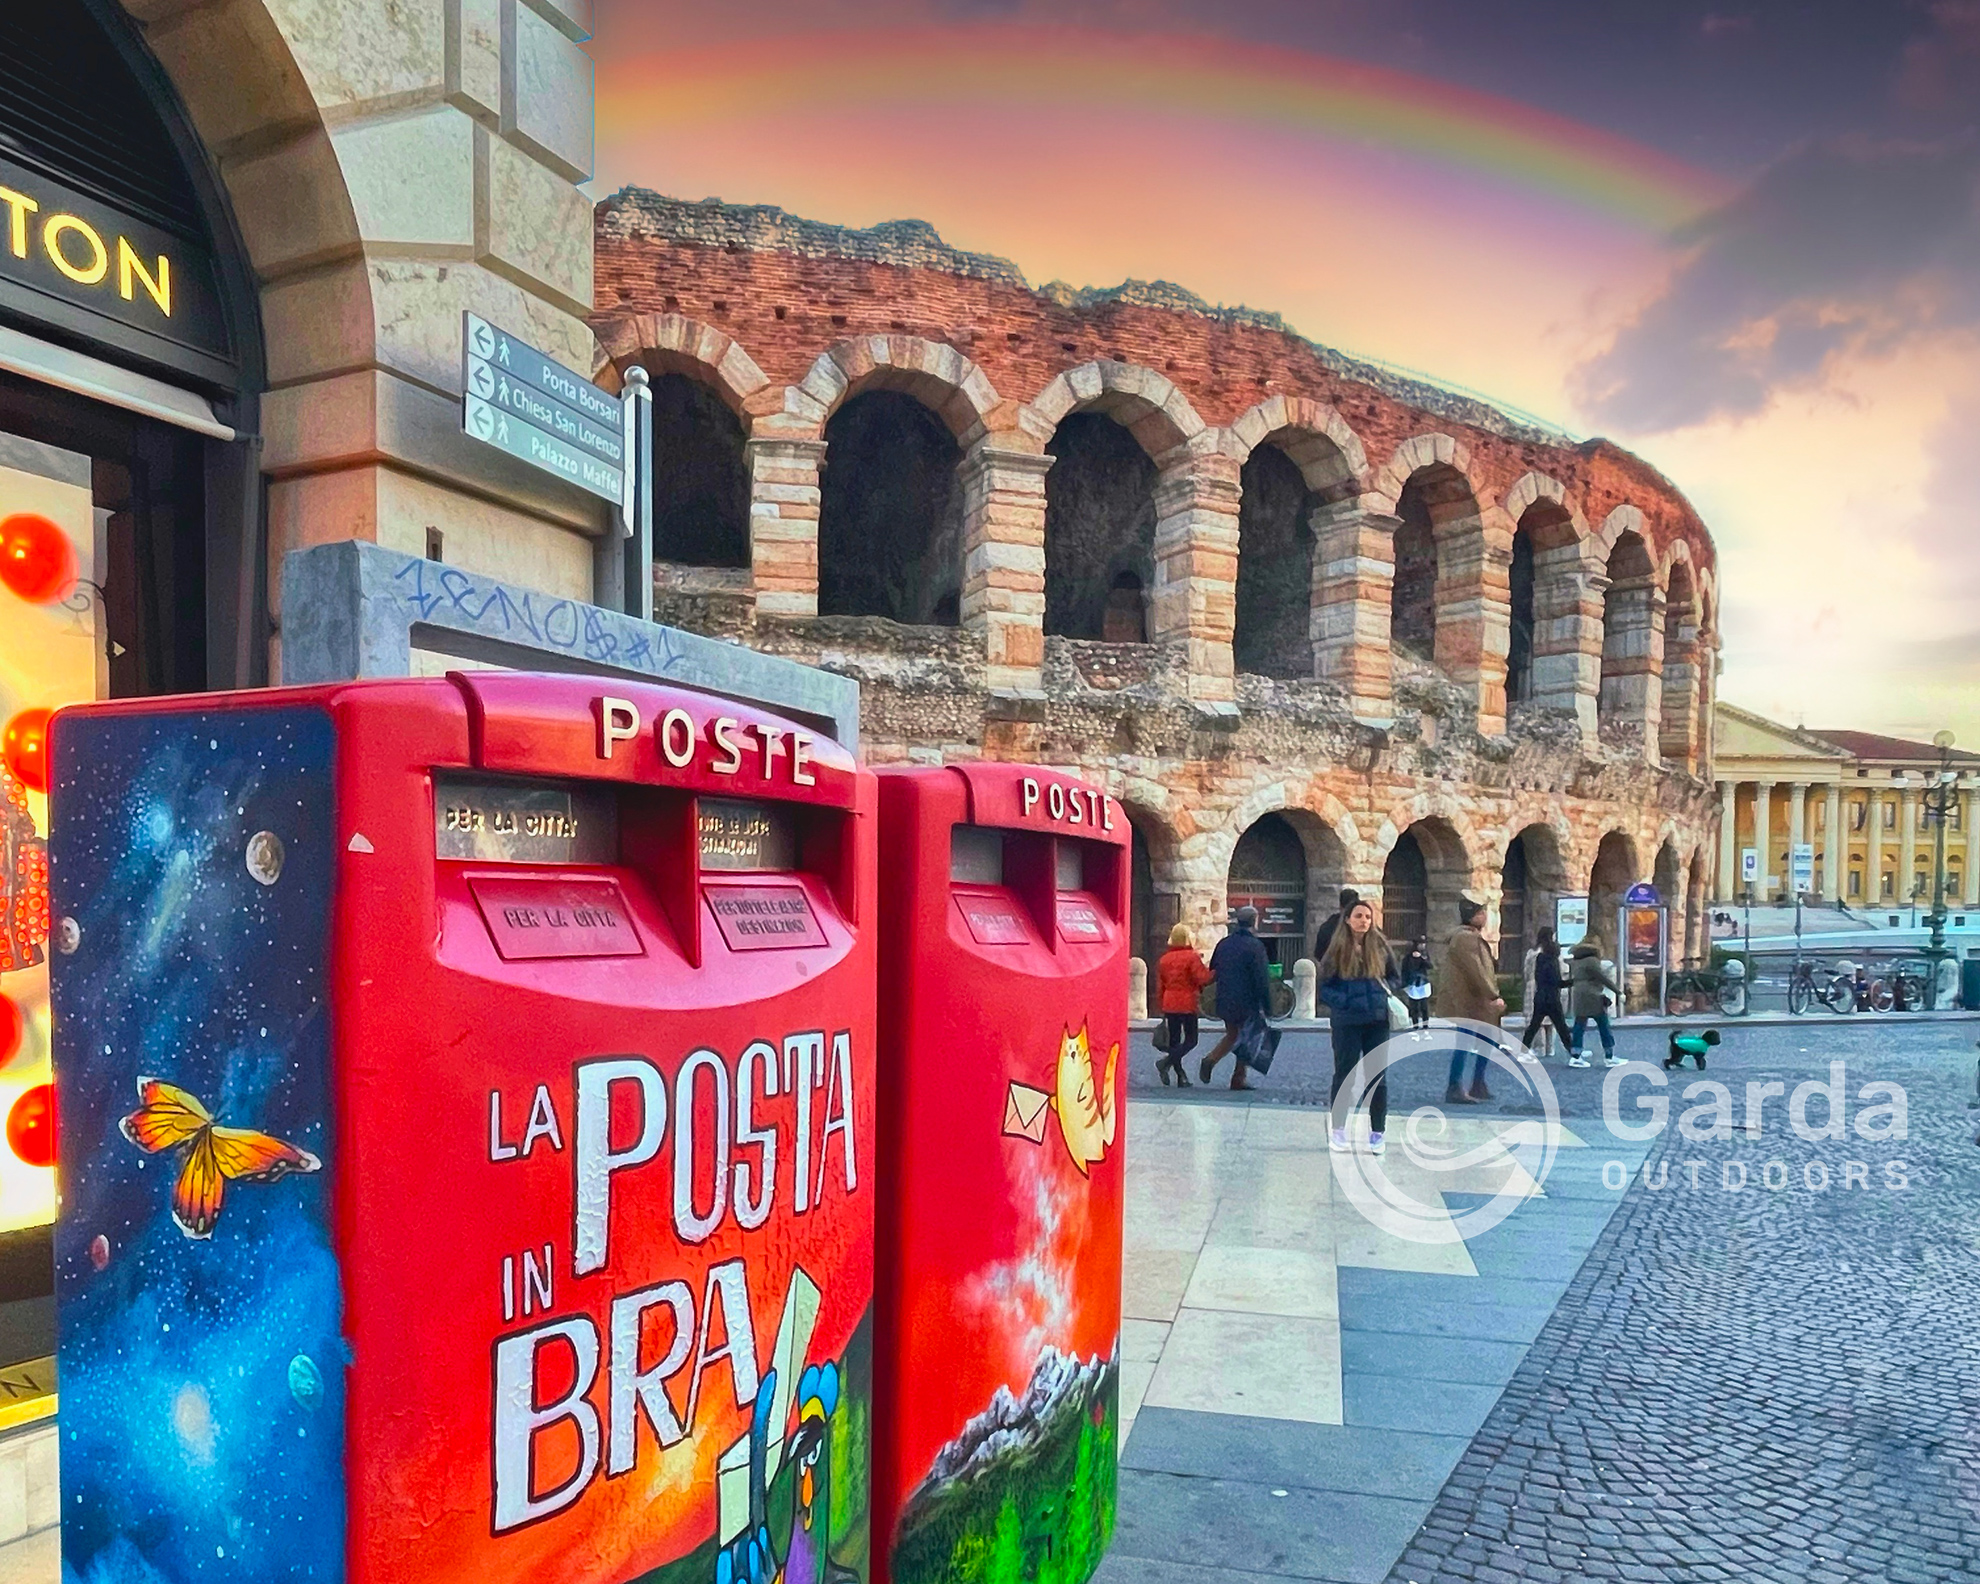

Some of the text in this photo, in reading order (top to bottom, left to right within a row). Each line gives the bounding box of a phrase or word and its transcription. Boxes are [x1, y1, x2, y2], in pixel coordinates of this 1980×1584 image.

[0, 185, 171, 318] TON
[512, 388, 621, 460] Chiesa San Lorenzo
[543, 365, 621, 425] Porta Borsari
[531, 436, 622, 495] Palazzo Maffei
[598, 695, 817, 787] POSTE
[493, 811, 519, 836] LA
[1020, 777, 1114, 831] POSTE
[503, 909, 540, 929] PER
[544, 909, 570, 928] LA
[488, 1028, 859, 1279] LA POSTA
[502, 1242, 554, 1322] IN
[491, 1256, 760, 1536] BRA
